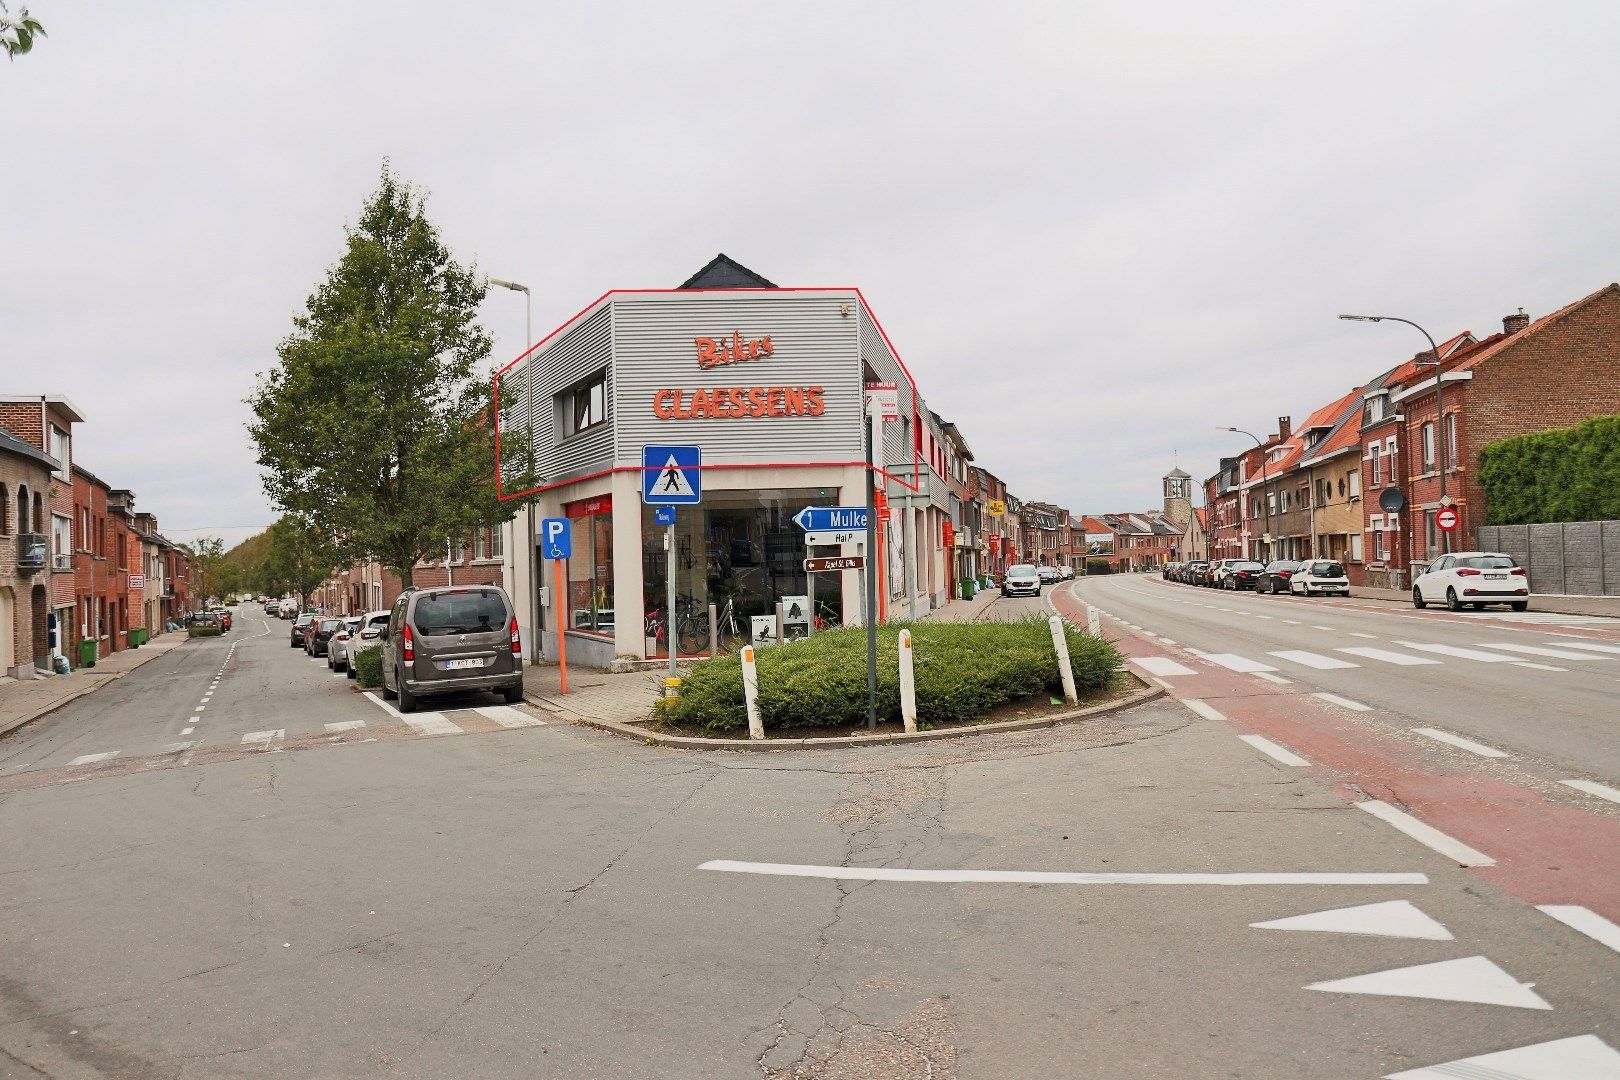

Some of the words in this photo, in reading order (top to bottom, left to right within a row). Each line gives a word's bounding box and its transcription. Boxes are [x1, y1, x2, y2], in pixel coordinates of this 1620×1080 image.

[694, 330, 774, 370] Bikes
[653, 386, 826, 420] CLAESSENS
[548, 521, 564, 544] P
[830, 510, 868, 527] Mulke
